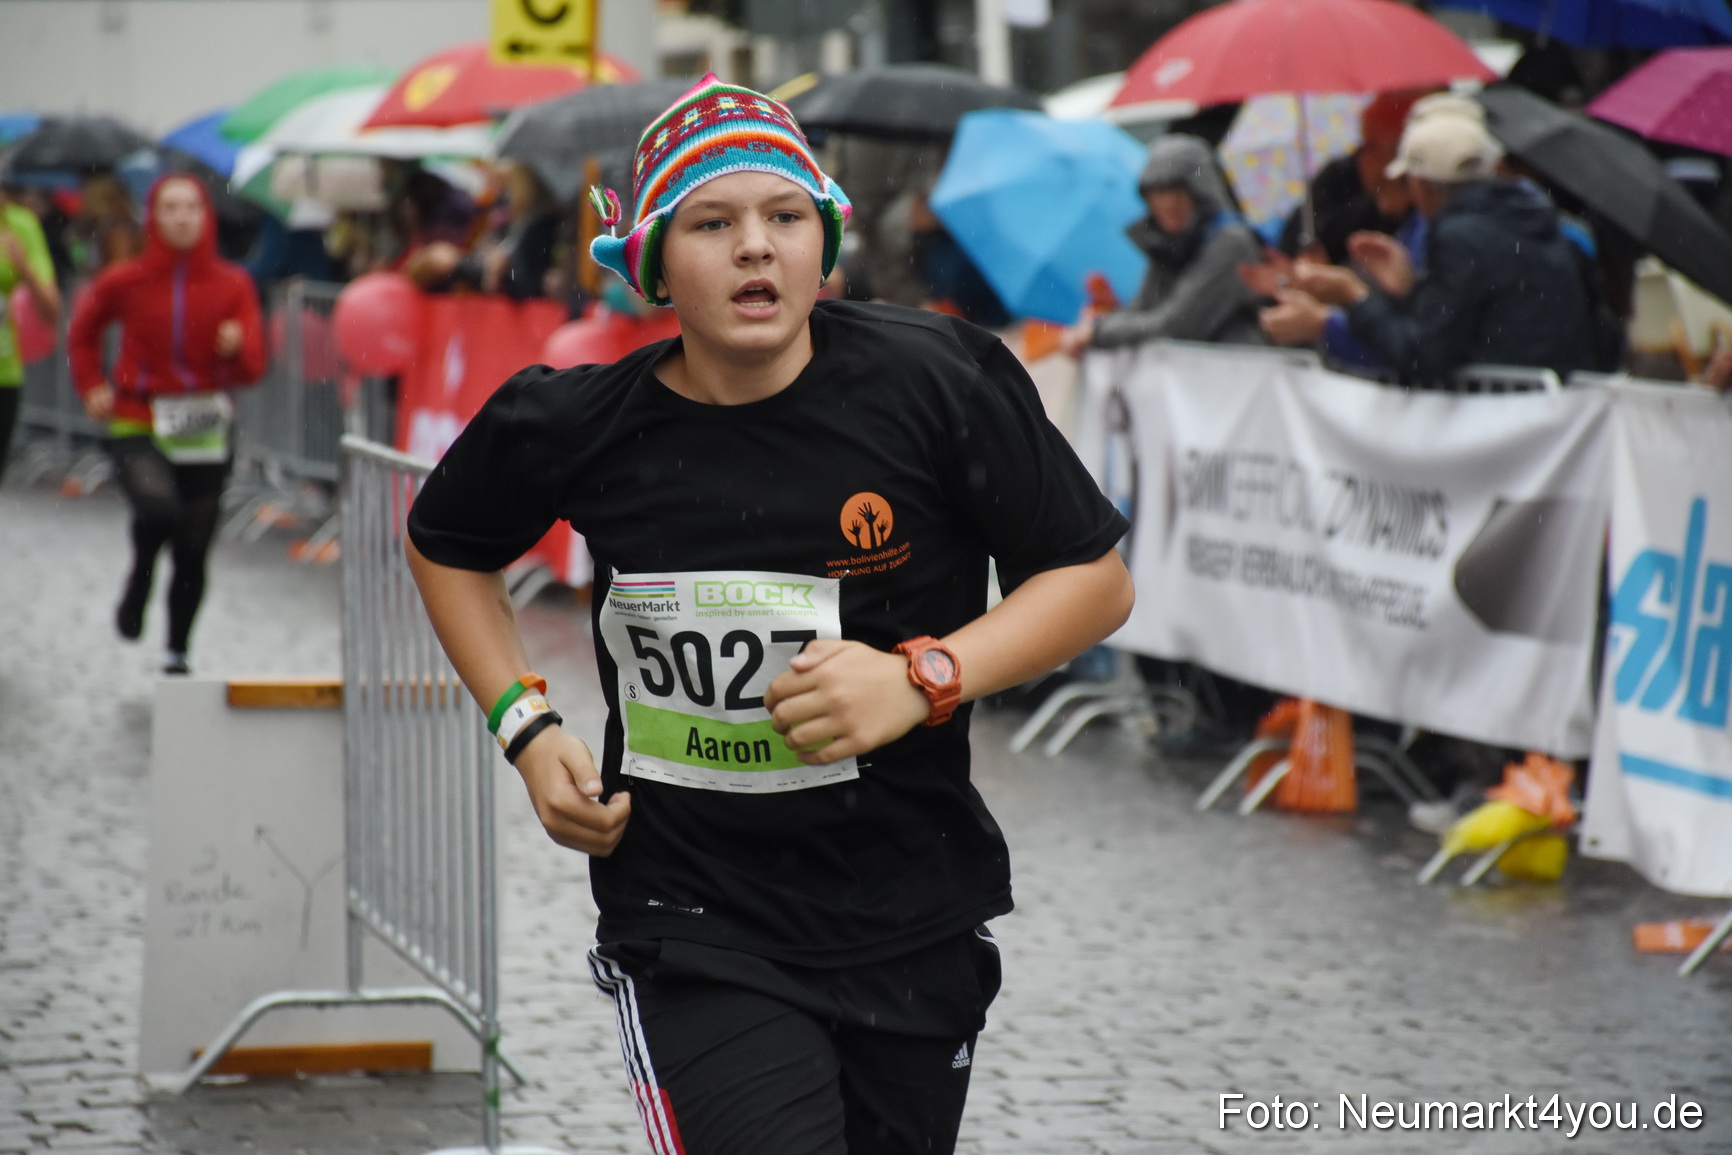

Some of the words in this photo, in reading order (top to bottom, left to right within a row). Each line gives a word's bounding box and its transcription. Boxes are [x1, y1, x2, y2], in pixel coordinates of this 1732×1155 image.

[826, 541, 910, 567] www.bolivienhilfe.com
[873, 563, 887, 573] AUF
[695, 581, 815, 608] BOCK
[609, 598, 680, 612] NeuerMarkt
[695, 609, 732, 618] inspired
[735, 609, 744, 618] by
[748, 609, 774, 617] smart
[777, 608, 818, 617] concepts
[629, 685, 636, 699] S
[685, 727, 772, 763] Aaron
